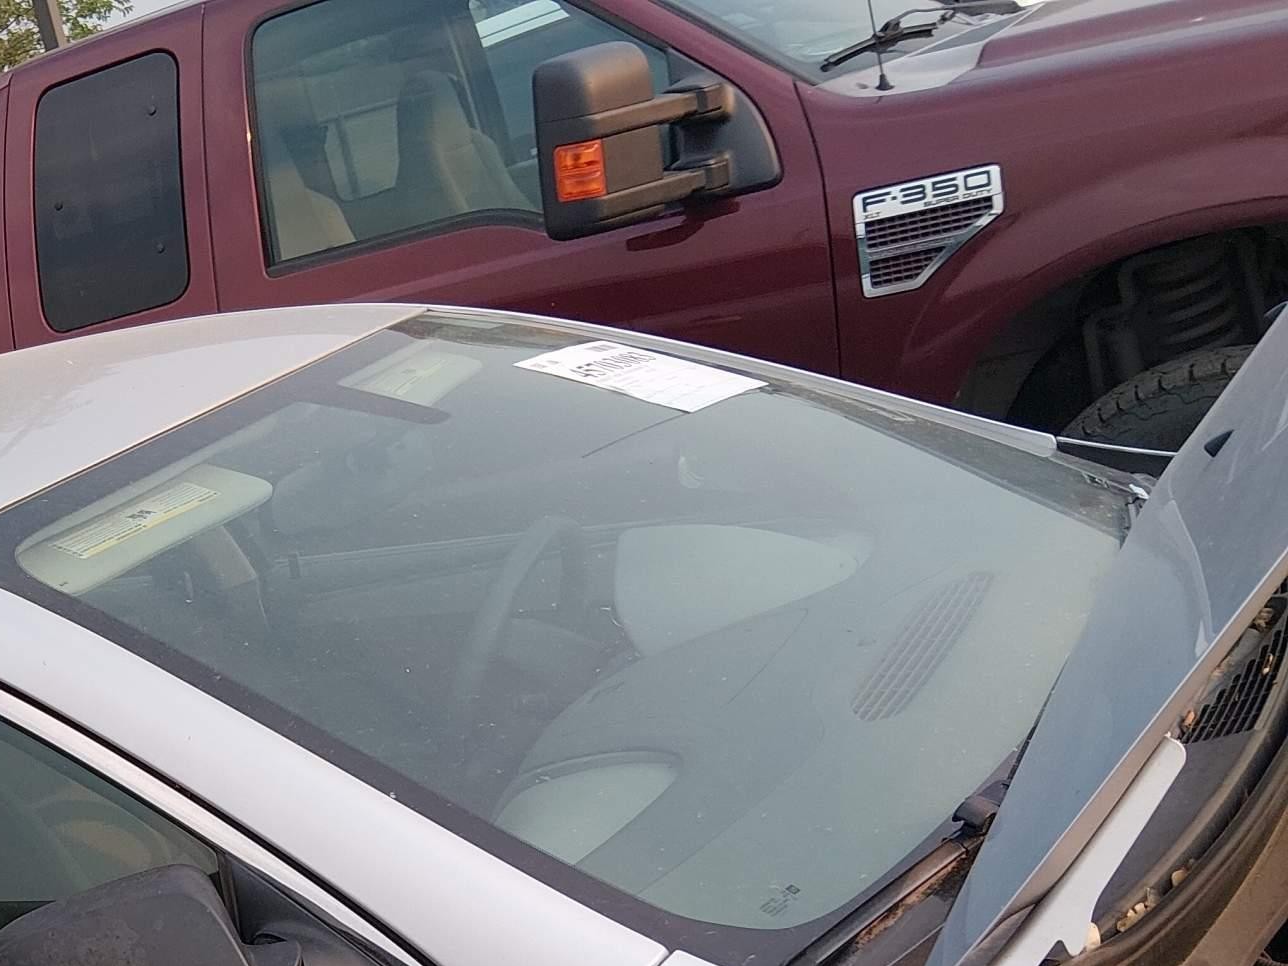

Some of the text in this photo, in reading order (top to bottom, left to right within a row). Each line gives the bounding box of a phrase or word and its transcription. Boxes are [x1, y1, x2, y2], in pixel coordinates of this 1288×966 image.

[863, 170, 991, 213] F-350
[923, 188, 992, 207] SUPER DUTY
[863, 211, 882, 220] XLT
